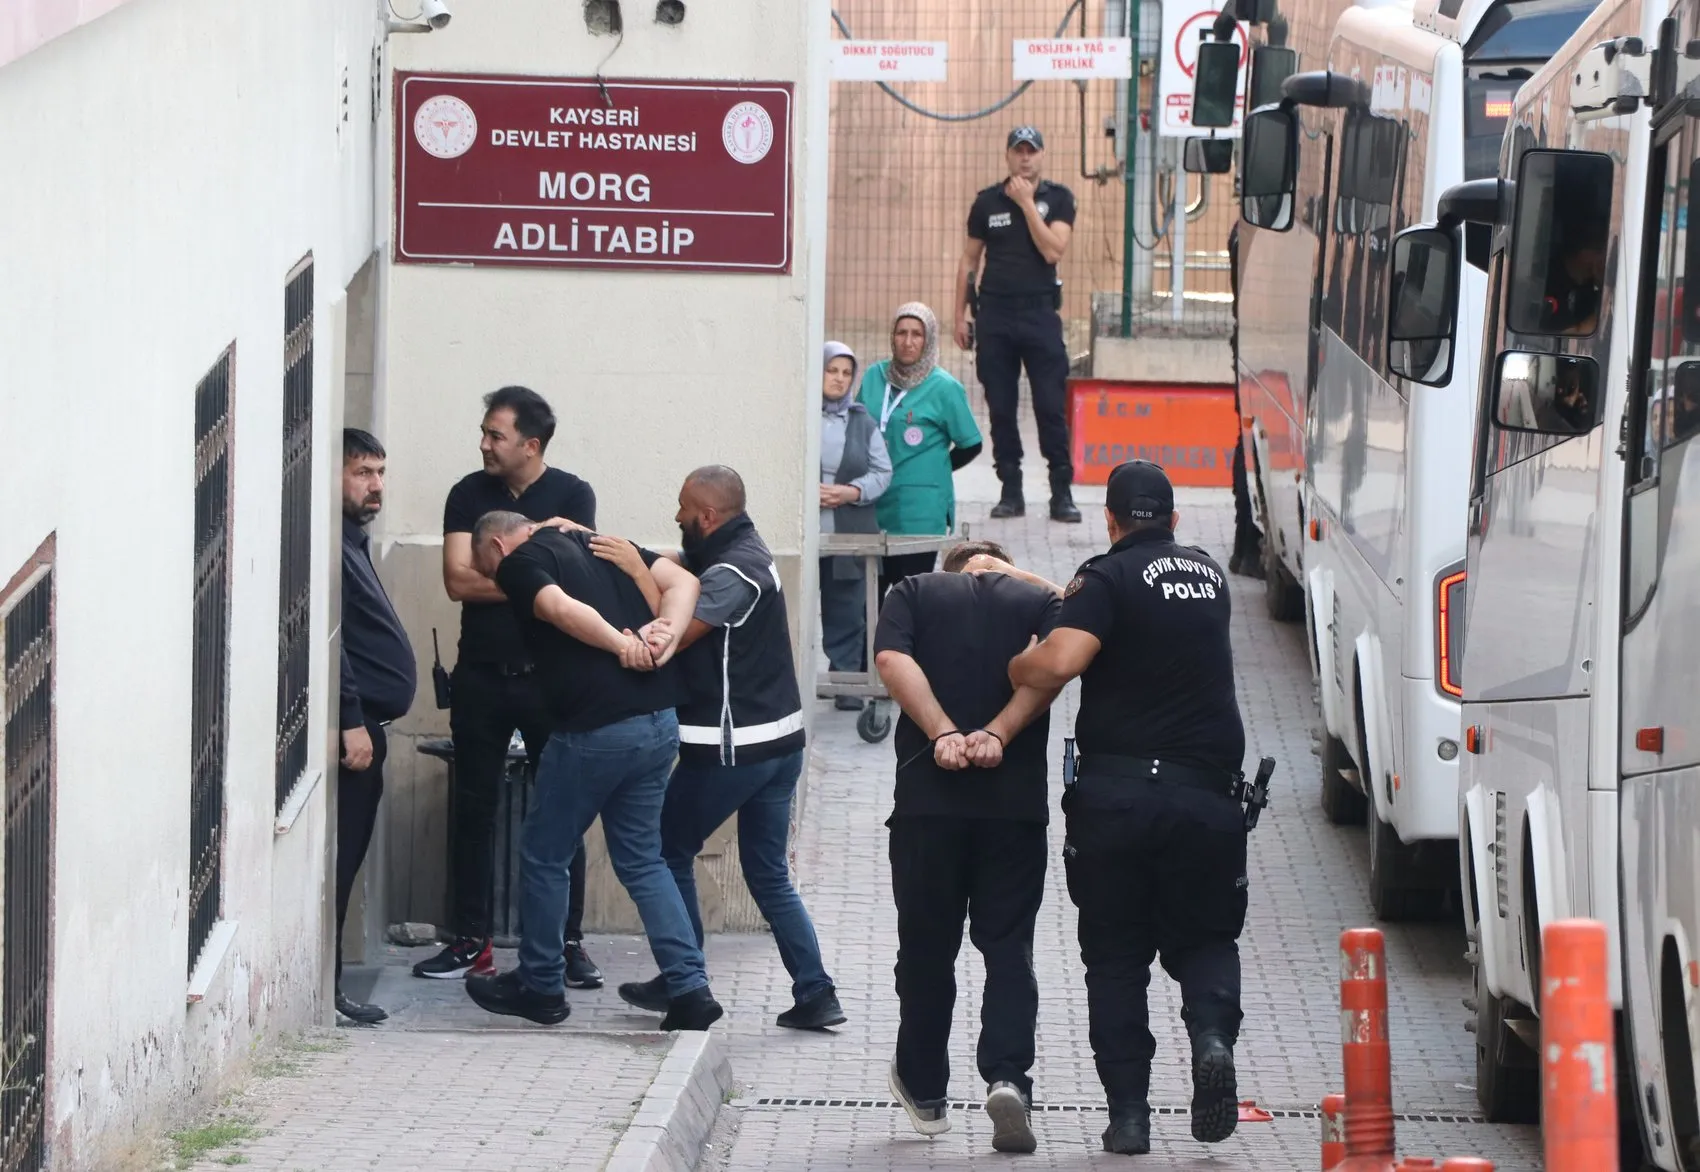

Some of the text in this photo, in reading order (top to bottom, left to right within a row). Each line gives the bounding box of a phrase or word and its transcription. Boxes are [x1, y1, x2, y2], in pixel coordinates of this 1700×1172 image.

[879, 60, 898, 70] GAZ
[1051, 57, 1095, 70] TEHLİKE
[550, 106, 639, 126] KAYSERİ
[491, 129, 697, 152] DEVLET HASTANESİ
[539, 172, 651, 202] MORG
[493, 218, 695, 255] ADLİ TABİP
[1175, 557, 1223, 589] KUVVET
